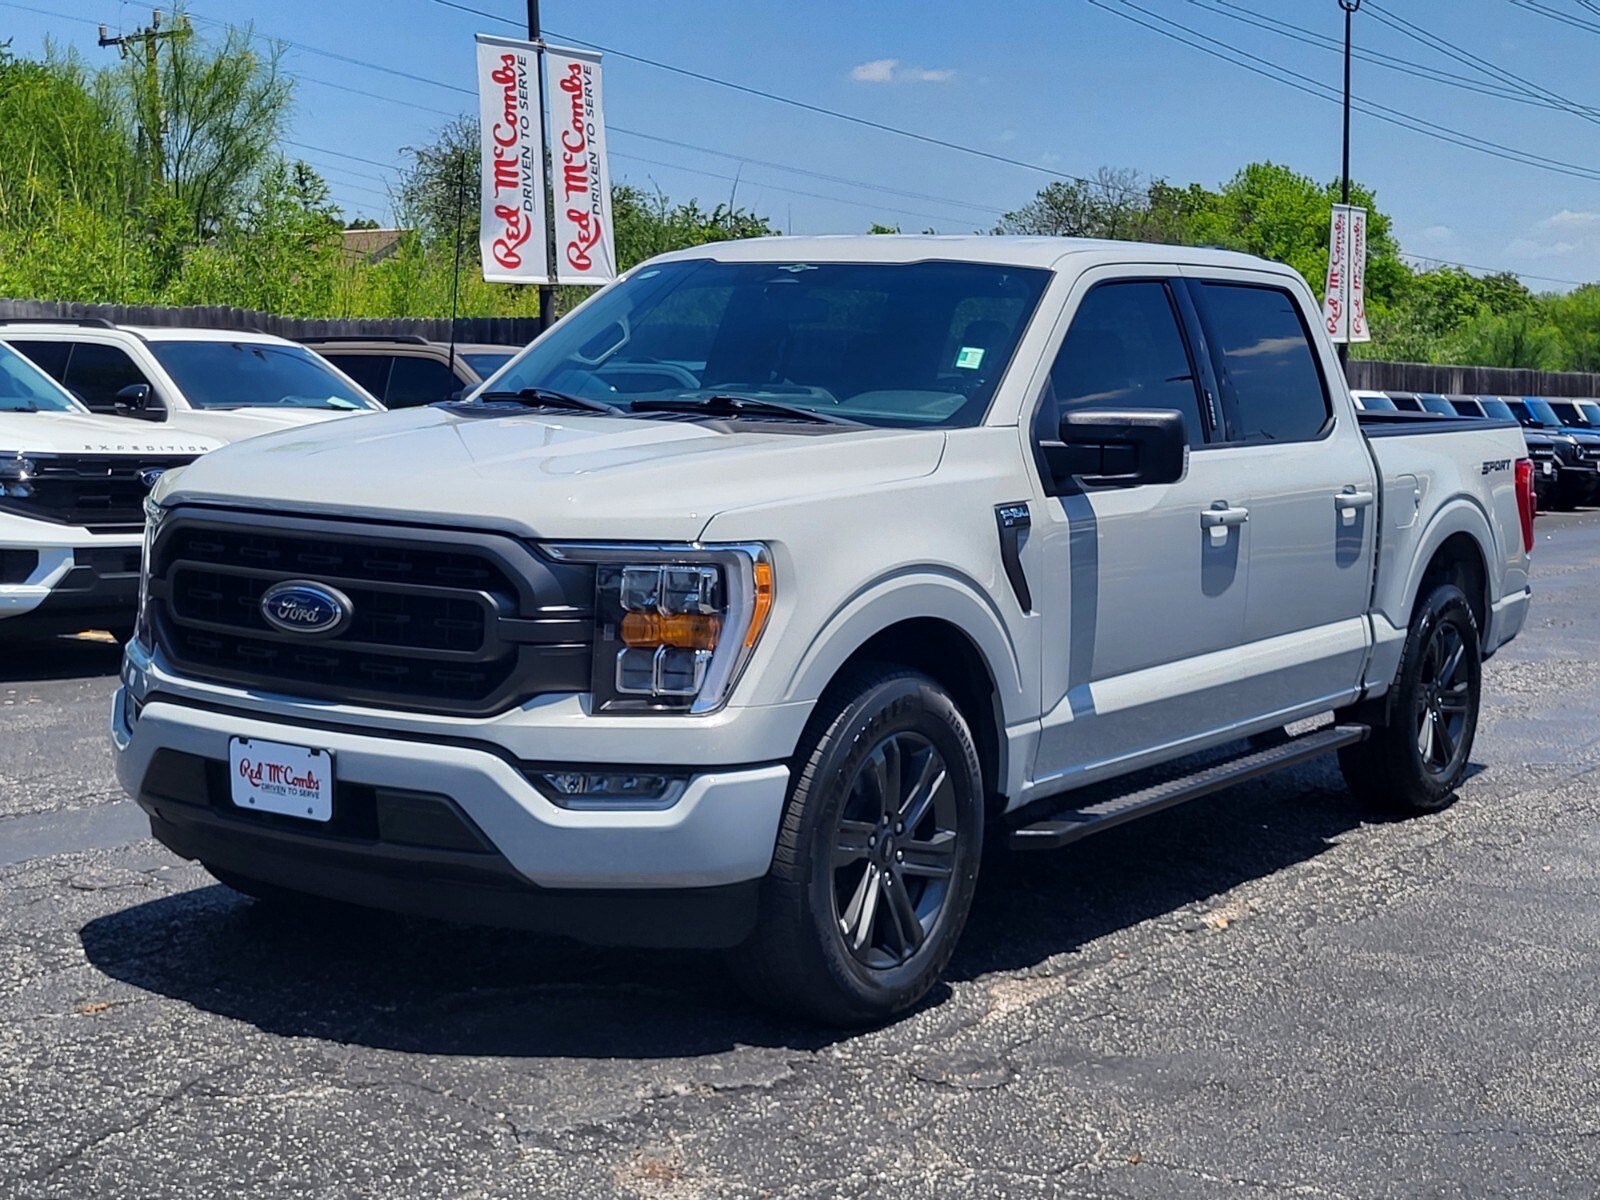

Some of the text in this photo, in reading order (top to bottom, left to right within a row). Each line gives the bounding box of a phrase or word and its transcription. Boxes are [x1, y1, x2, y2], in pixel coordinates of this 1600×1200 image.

[517, 54, 533, 213] DRIVEN TO SERVE
[582, 64, 601, 216] DRIVEN TO SERVE
[491, 53, 531, 270] Red McCombs
[560, 63, 600, 271] Red McCombs
[83, 444, 209, 452] EXPEDITION
[1481, 459, 1512, 475] SPORT
[277, 595, 320, 623] Ford
[240, 758, 320, 791] Red McCombs
[261, 782, 320, 800] DRIVEN TO SERVE
